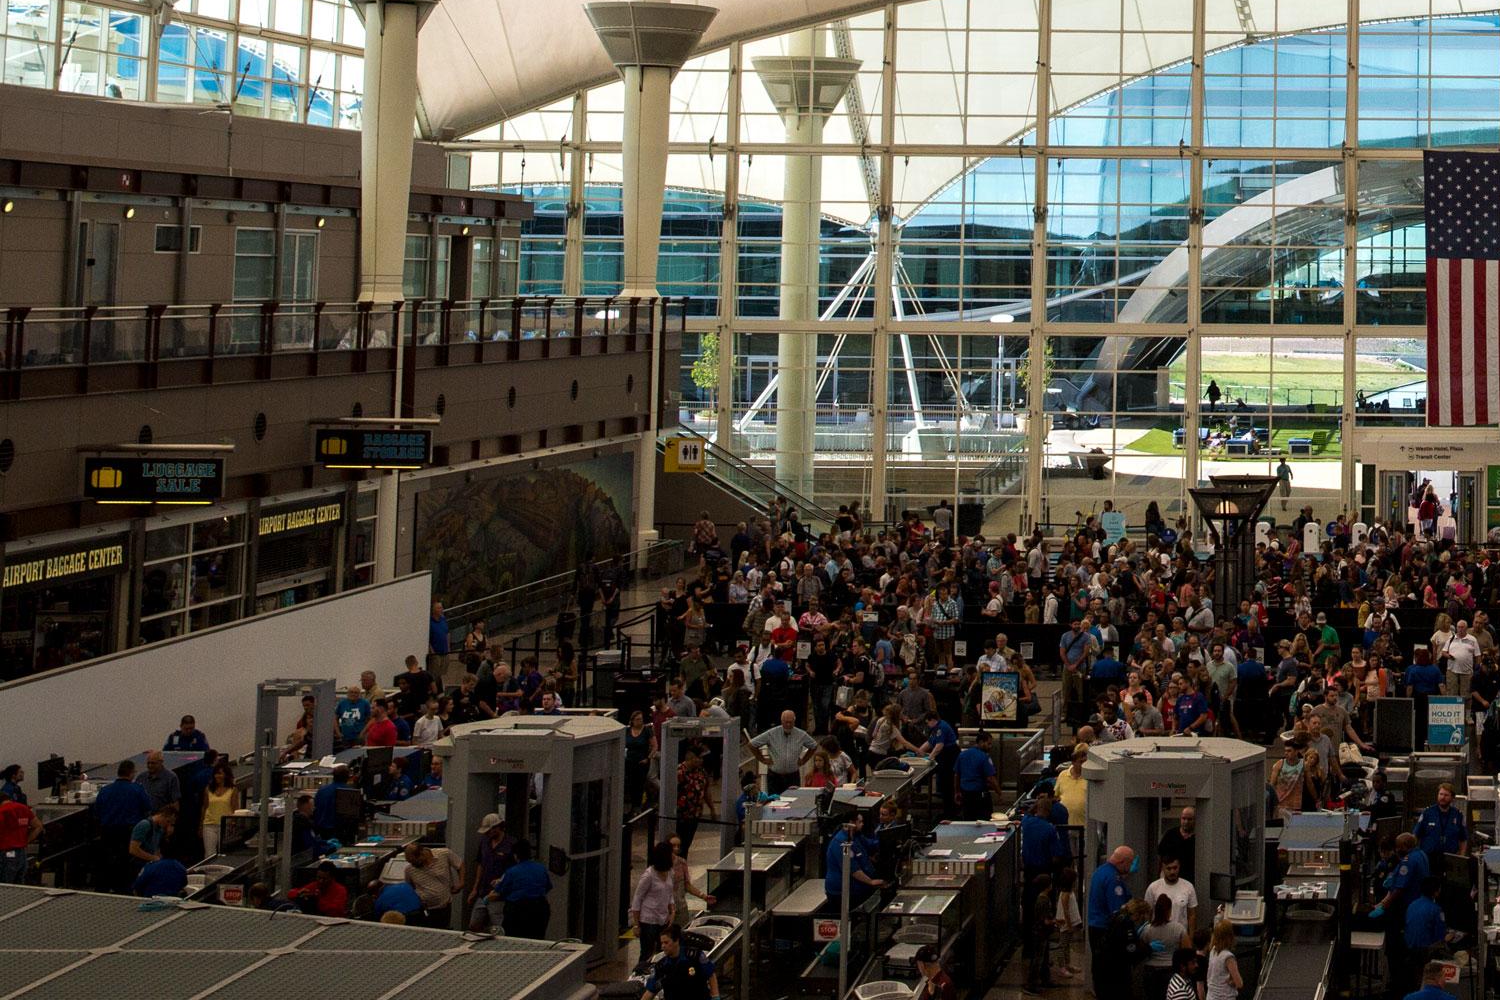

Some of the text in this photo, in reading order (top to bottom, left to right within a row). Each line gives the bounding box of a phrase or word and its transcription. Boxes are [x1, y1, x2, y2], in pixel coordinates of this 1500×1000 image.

[142, 462, 217, 478] LUGGAGE
[155, 478, 201, 494] SALE
[315, 503, 341, 525] CENTER
[2, 545, 123, 588] AIRPORT BAGGAGE CENTER
